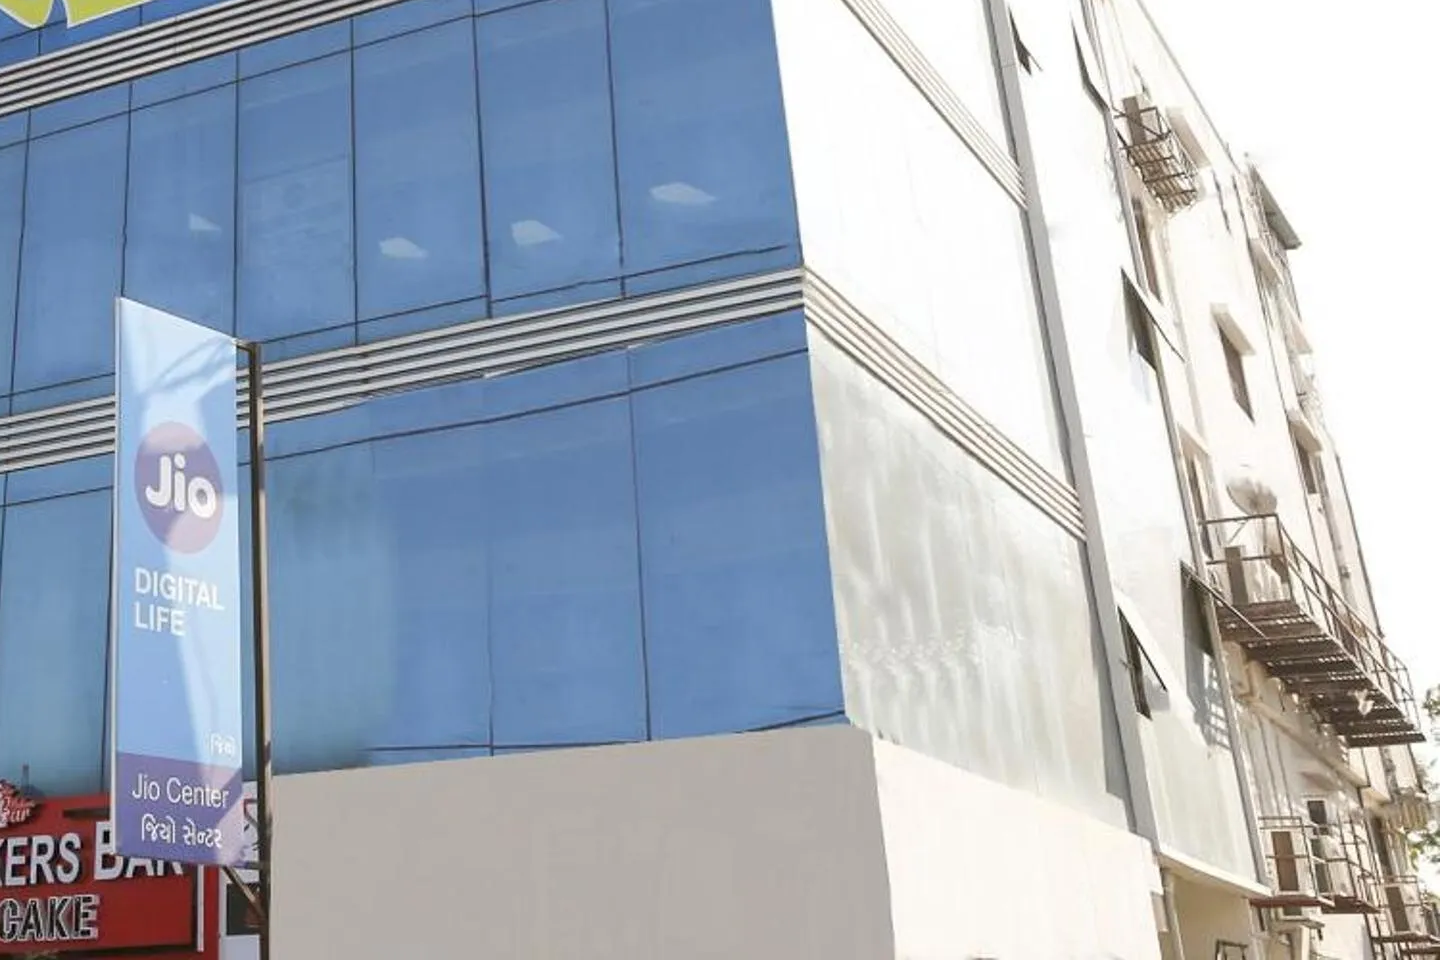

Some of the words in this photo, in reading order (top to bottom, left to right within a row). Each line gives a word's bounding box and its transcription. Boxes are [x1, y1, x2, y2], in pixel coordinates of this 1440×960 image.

[145, 452, 217, 519] Jio
[134, 566, 225, 611] DIGITAL
[134, 601, 187, 638] LIFE
[132, 773, 160, 801] Jio
[166, 776, 229, 809] Center
